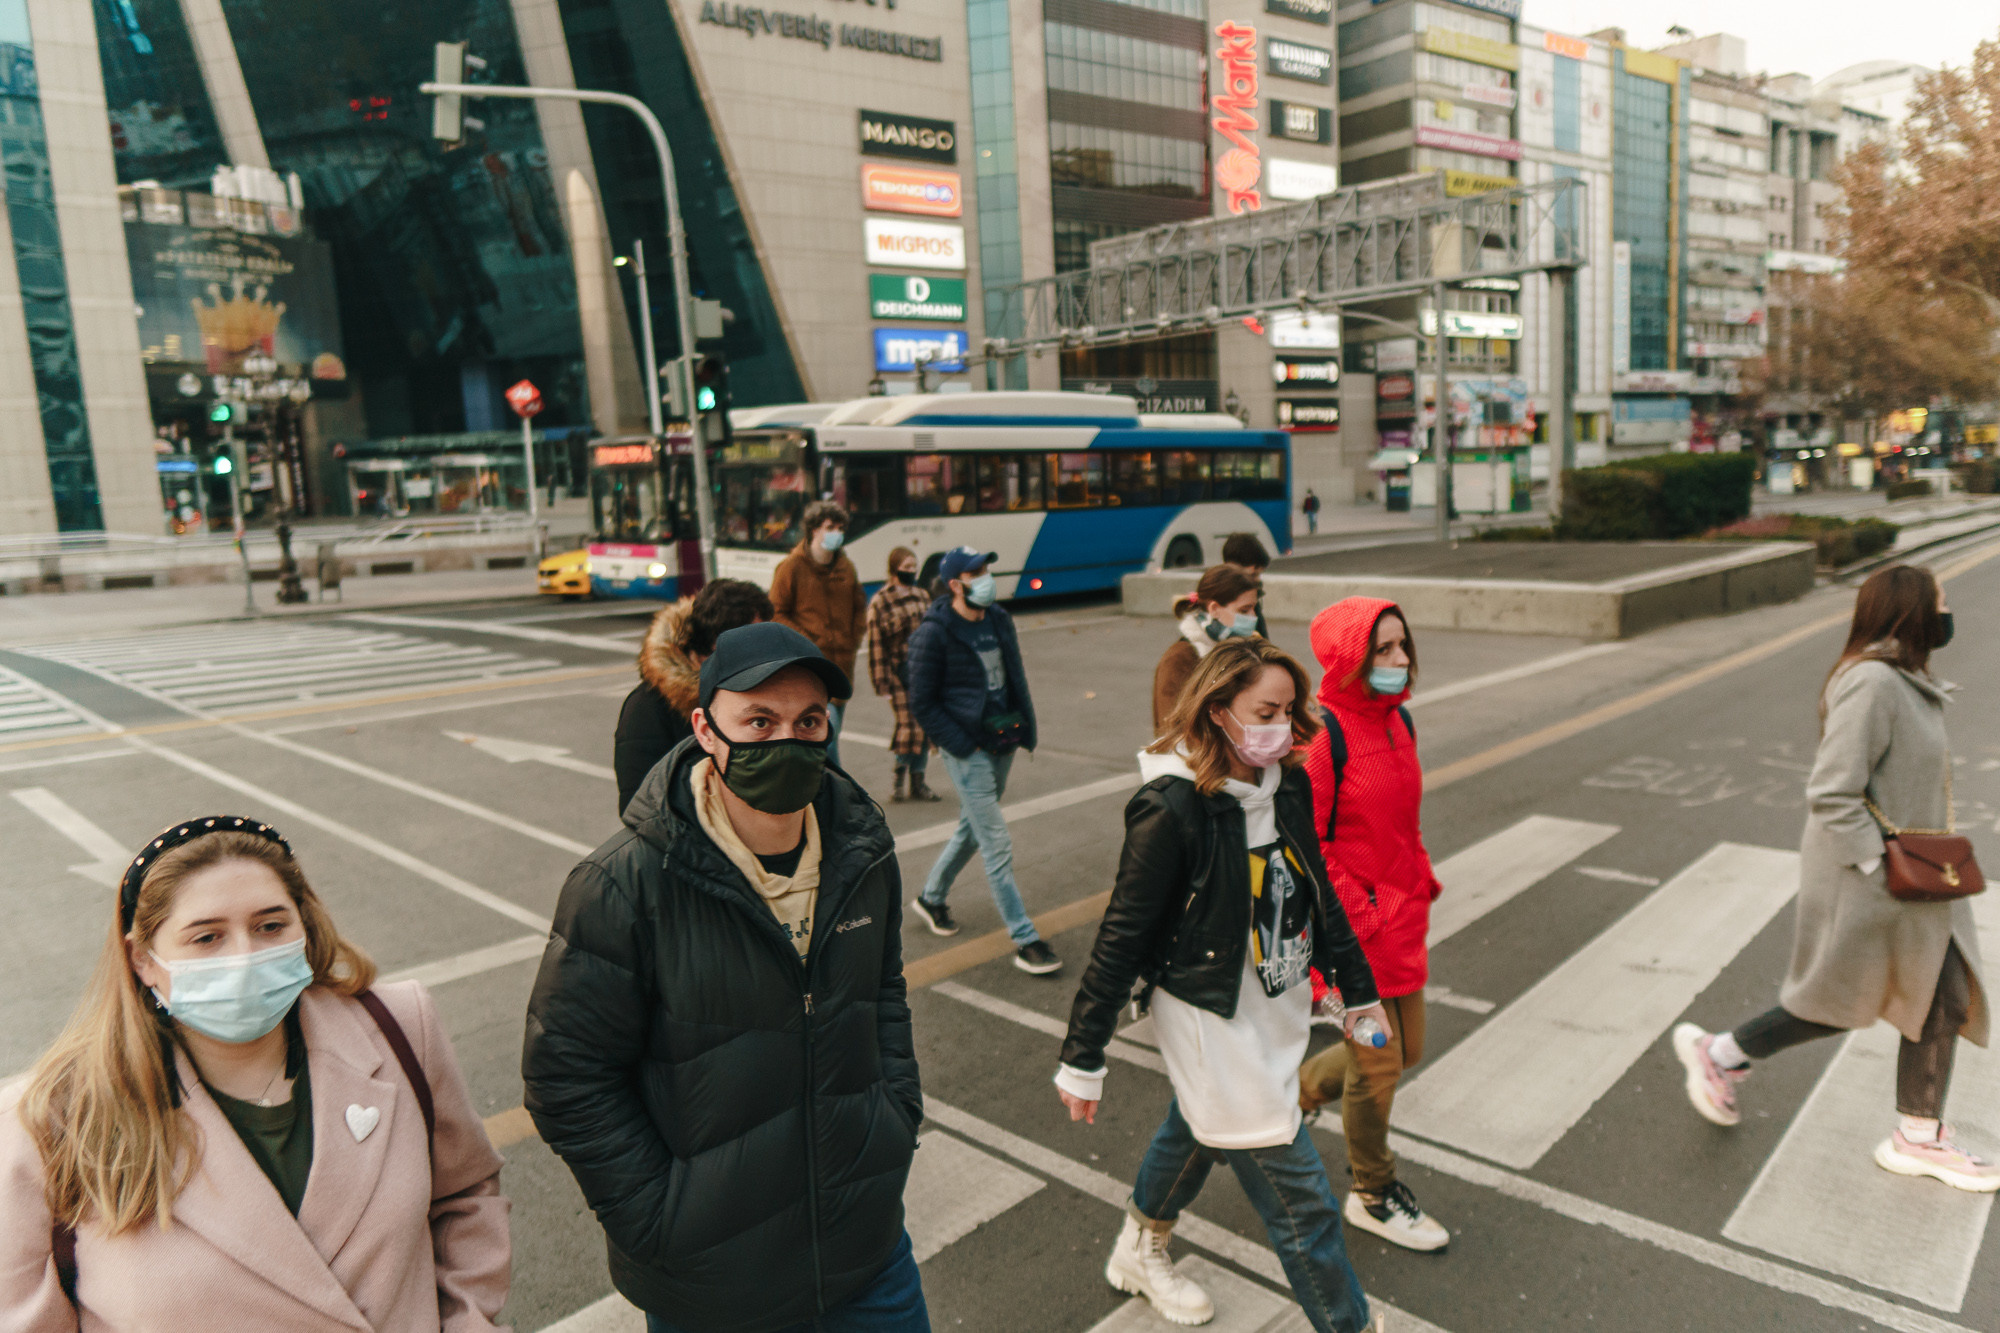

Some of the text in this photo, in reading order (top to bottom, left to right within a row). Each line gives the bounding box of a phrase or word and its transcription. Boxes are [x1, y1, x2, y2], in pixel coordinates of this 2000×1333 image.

[862, 120, 954, 151] MANGO
[905, 277, 931, 302] D
[876, 301, 963, 317] DEICHMANN
[843, 916, 872, 930] Columbia
